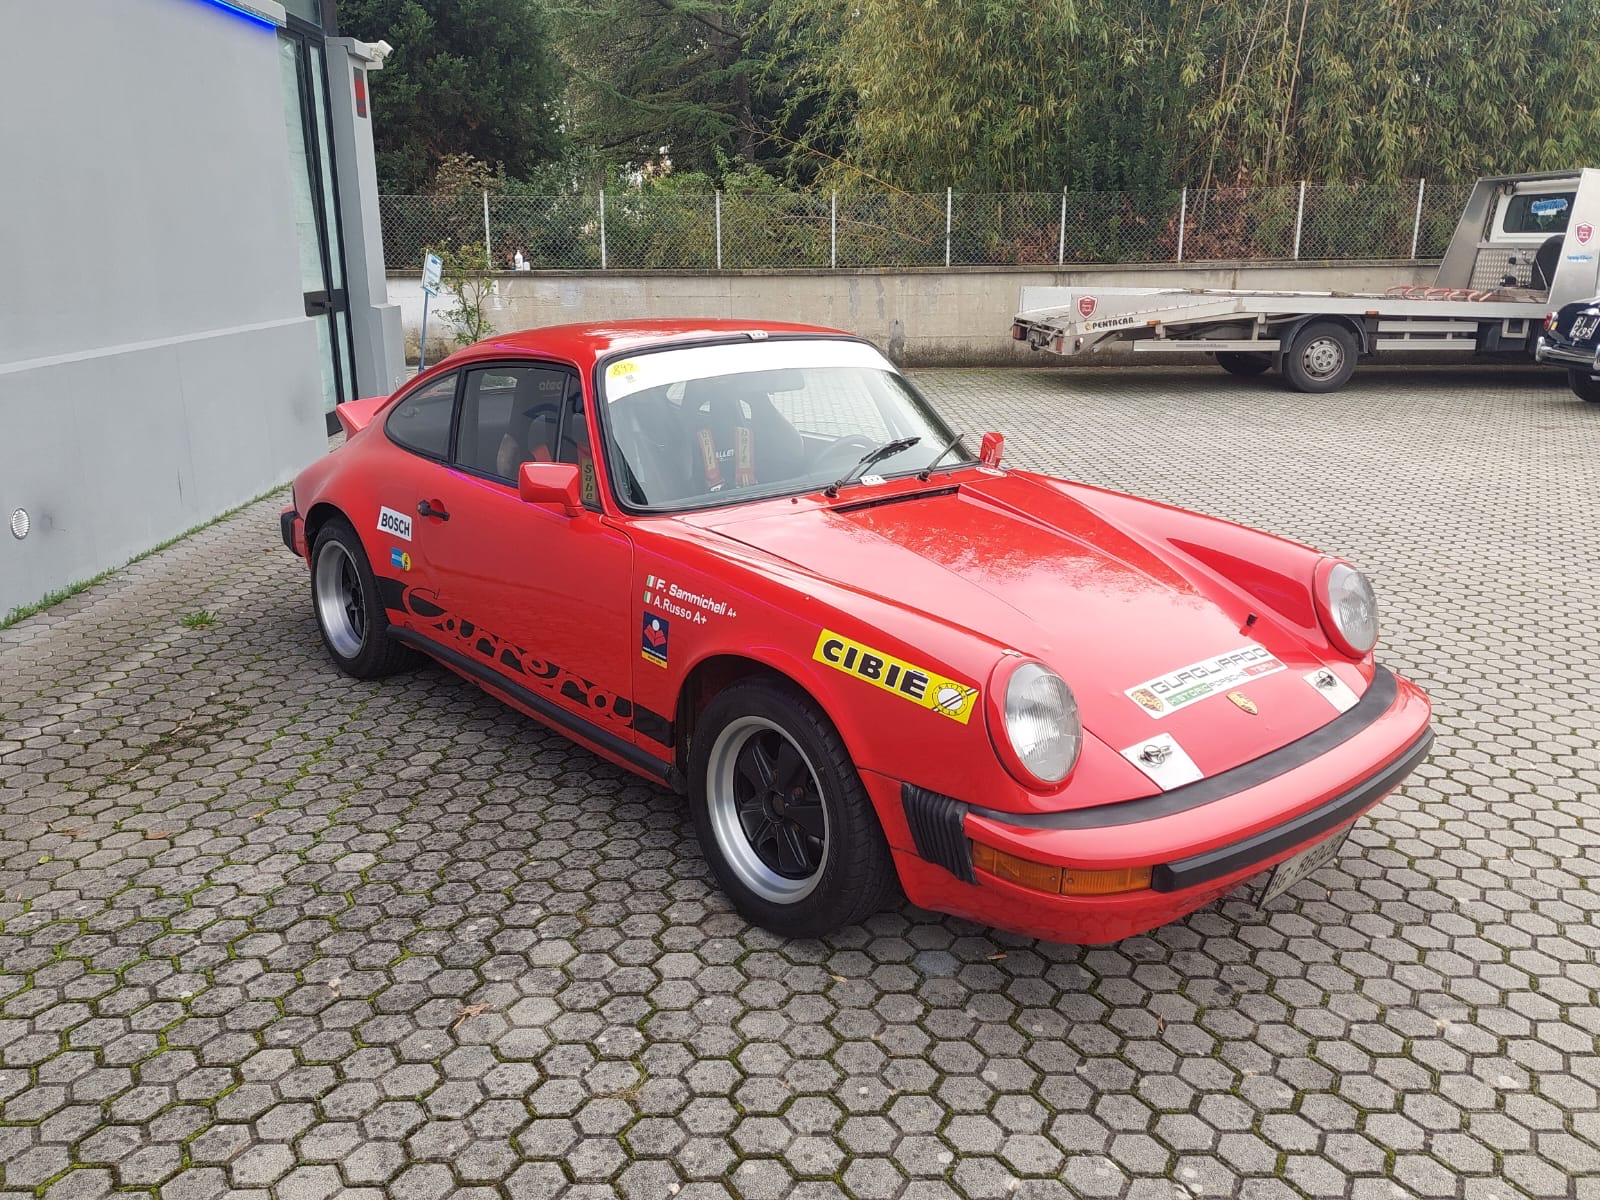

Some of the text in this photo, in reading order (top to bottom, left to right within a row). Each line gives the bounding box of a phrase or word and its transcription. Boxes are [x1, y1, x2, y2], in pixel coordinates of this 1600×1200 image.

[1092, 316, 1134, 329] PENTACAR
[381, 512, 410, 537] BOSCH
[653, 595, 707, 624] A.Russo A+
[656, 578, 737, 618] F. Sammicheli A+
[402, 588, 634, 729] Carrera
[1150, 647, 1269, 694] GUAGLIARDO
